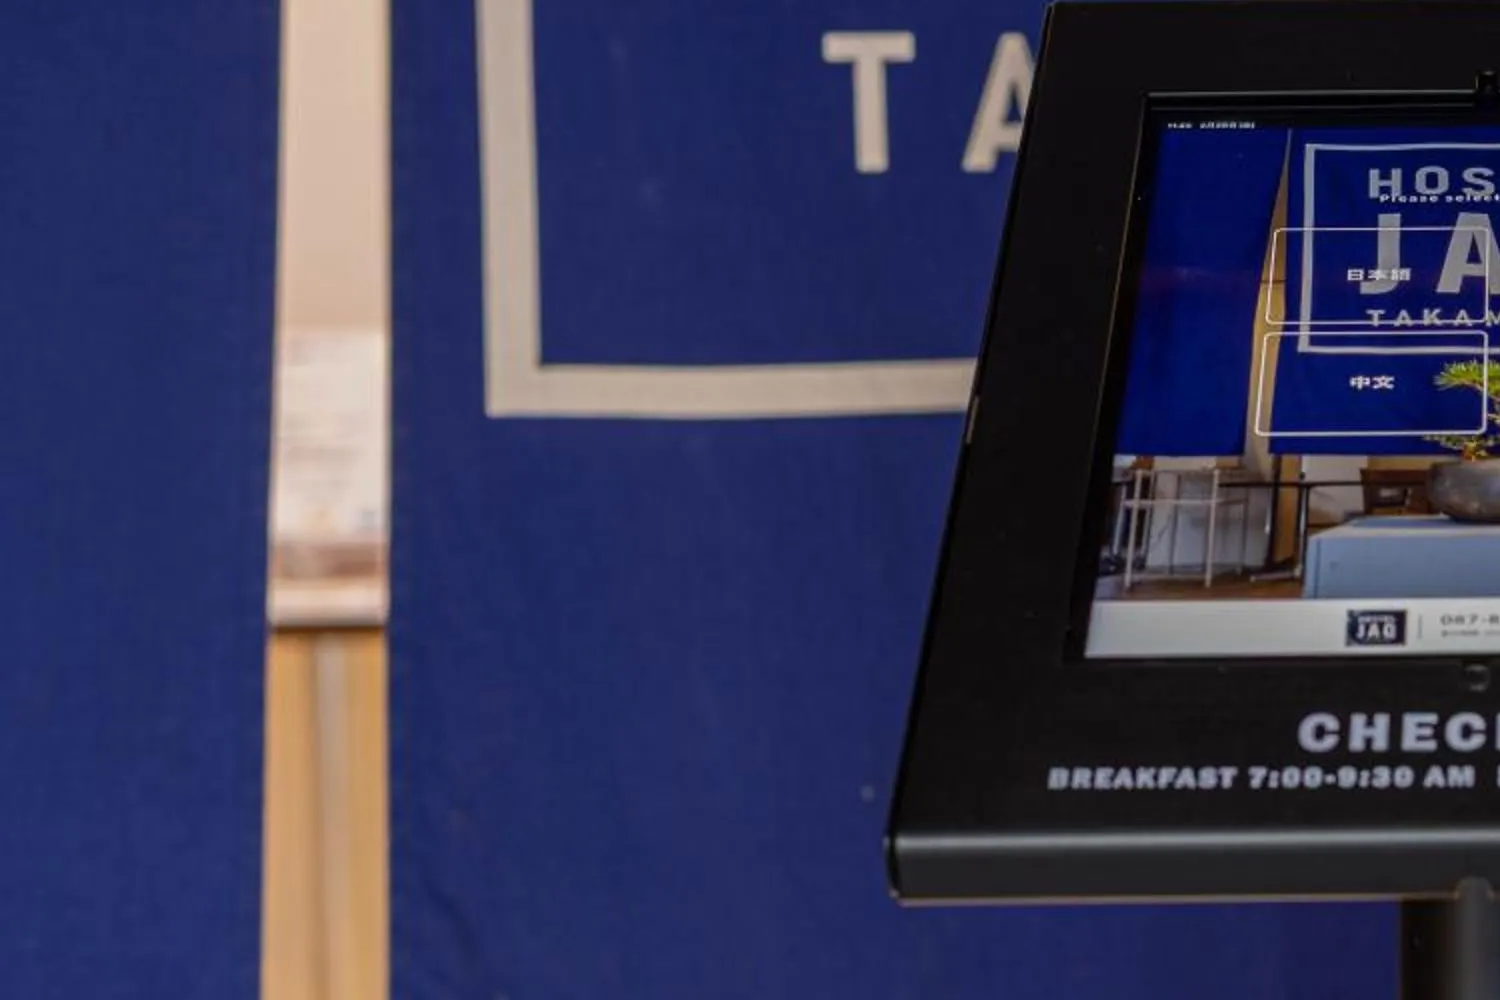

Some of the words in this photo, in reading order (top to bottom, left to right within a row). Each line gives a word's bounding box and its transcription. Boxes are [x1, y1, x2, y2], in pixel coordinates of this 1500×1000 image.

[1379, 192, 1439, 203] Please
[1445, 191, 1500, 203] select
[1346, 267, 1412, 281] 日本語
[1349, 375, 1395, 390] 中文
[1047, 767, 1239, 790] BREAKFAST
[1247, 766, 1415, 789] 7:00-9:30
[1422, 765, 1476, 788] AM
